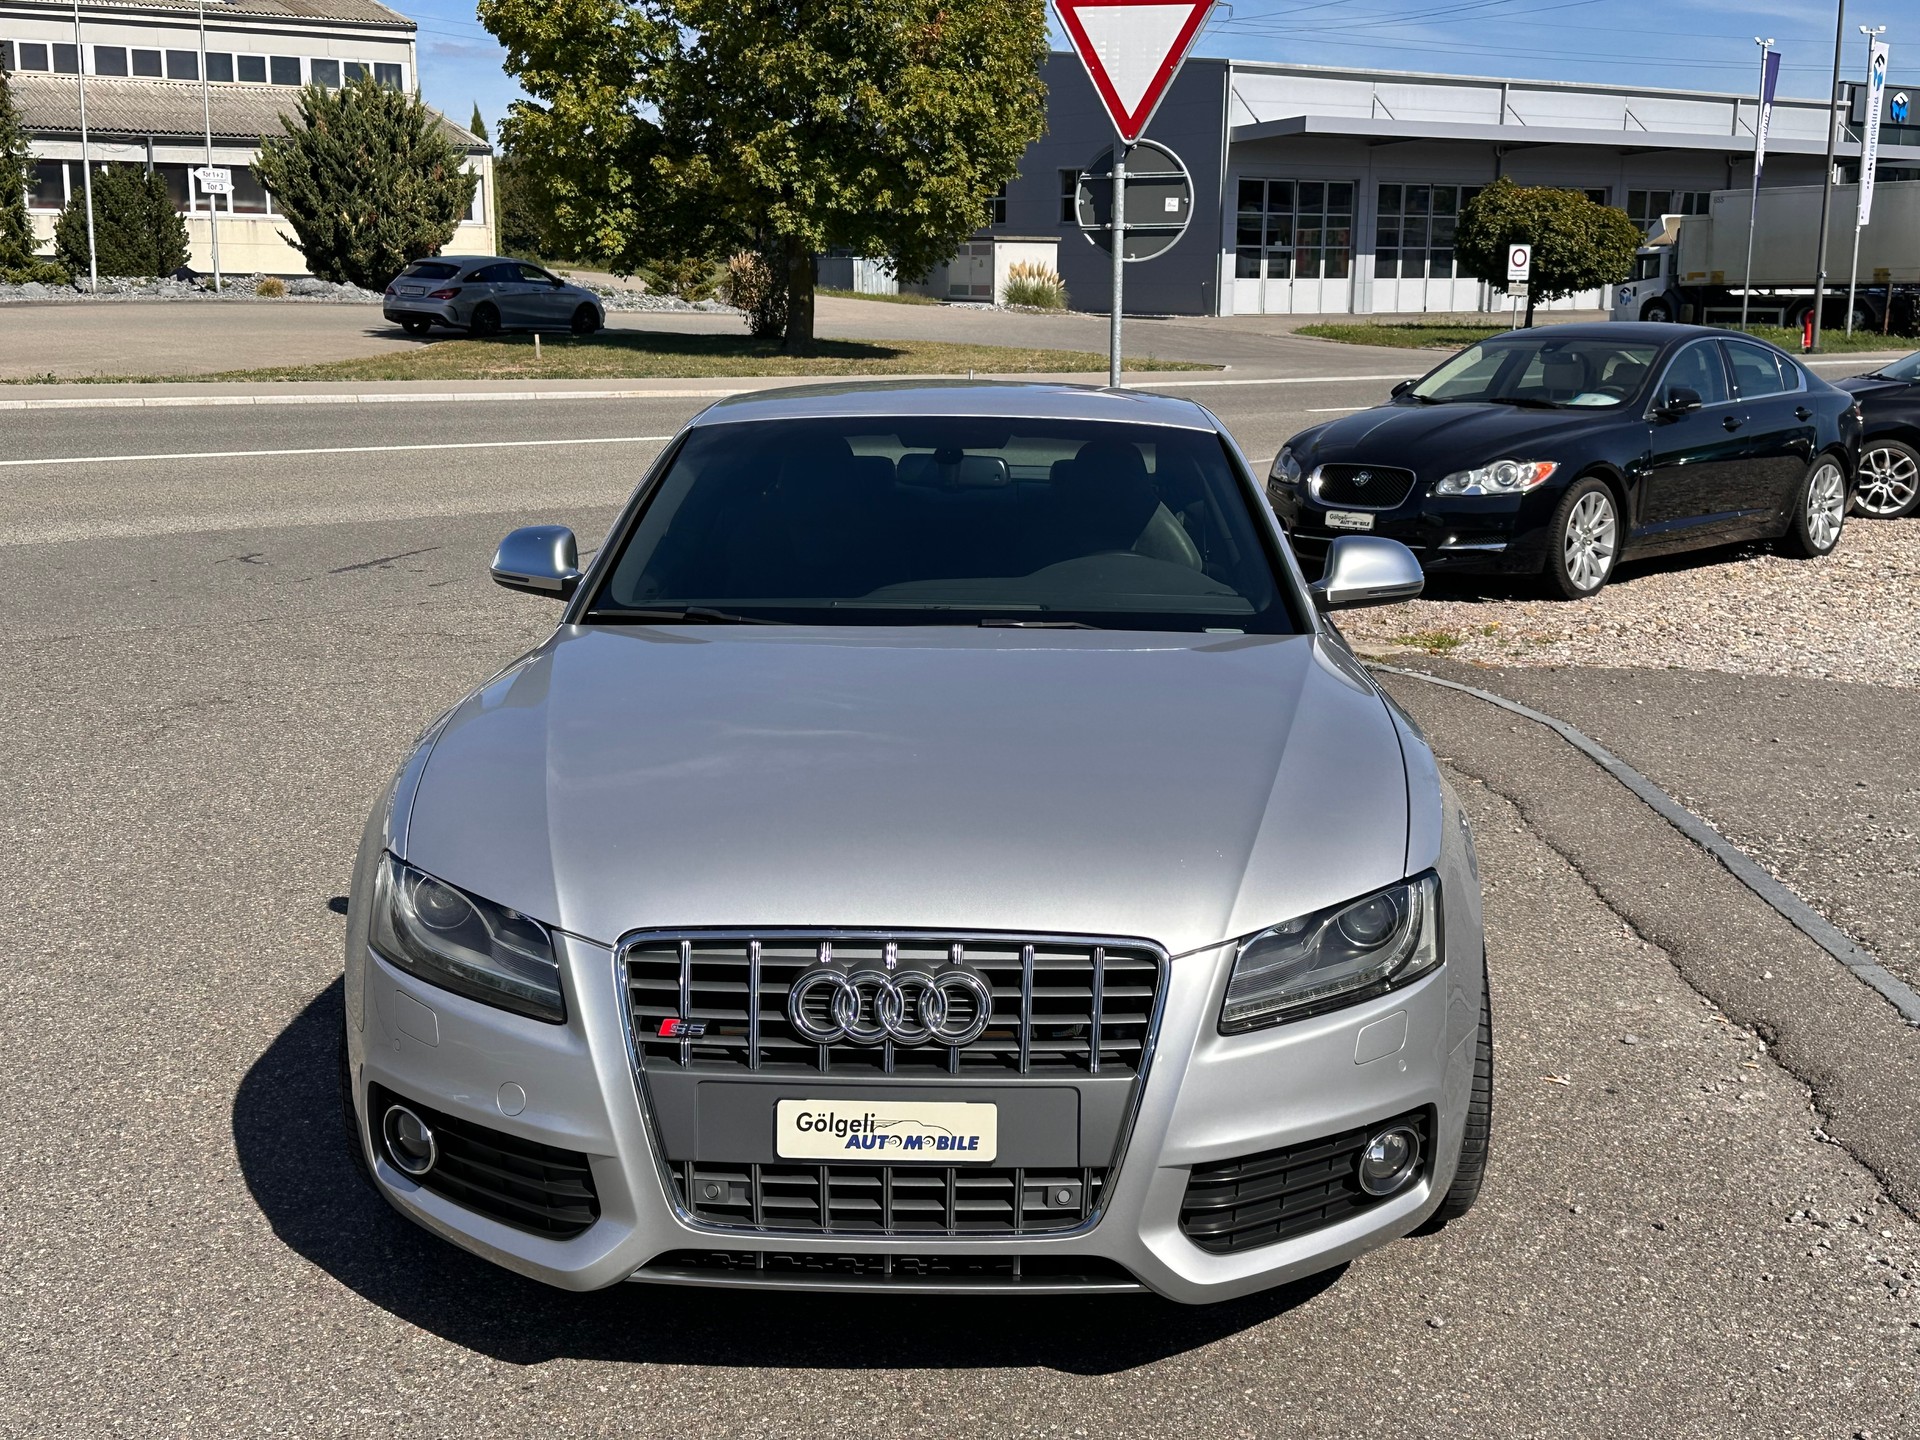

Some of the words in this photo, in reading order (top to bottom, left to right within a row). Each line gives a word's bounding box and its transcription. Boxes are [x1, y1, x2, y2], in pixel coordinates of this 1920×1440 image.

[670, 1023, 706, 1036] S5
[796, 1112, 876, 1138] Gölgeli
[845, 1134, 980, 1151] AUTOMOBILE
